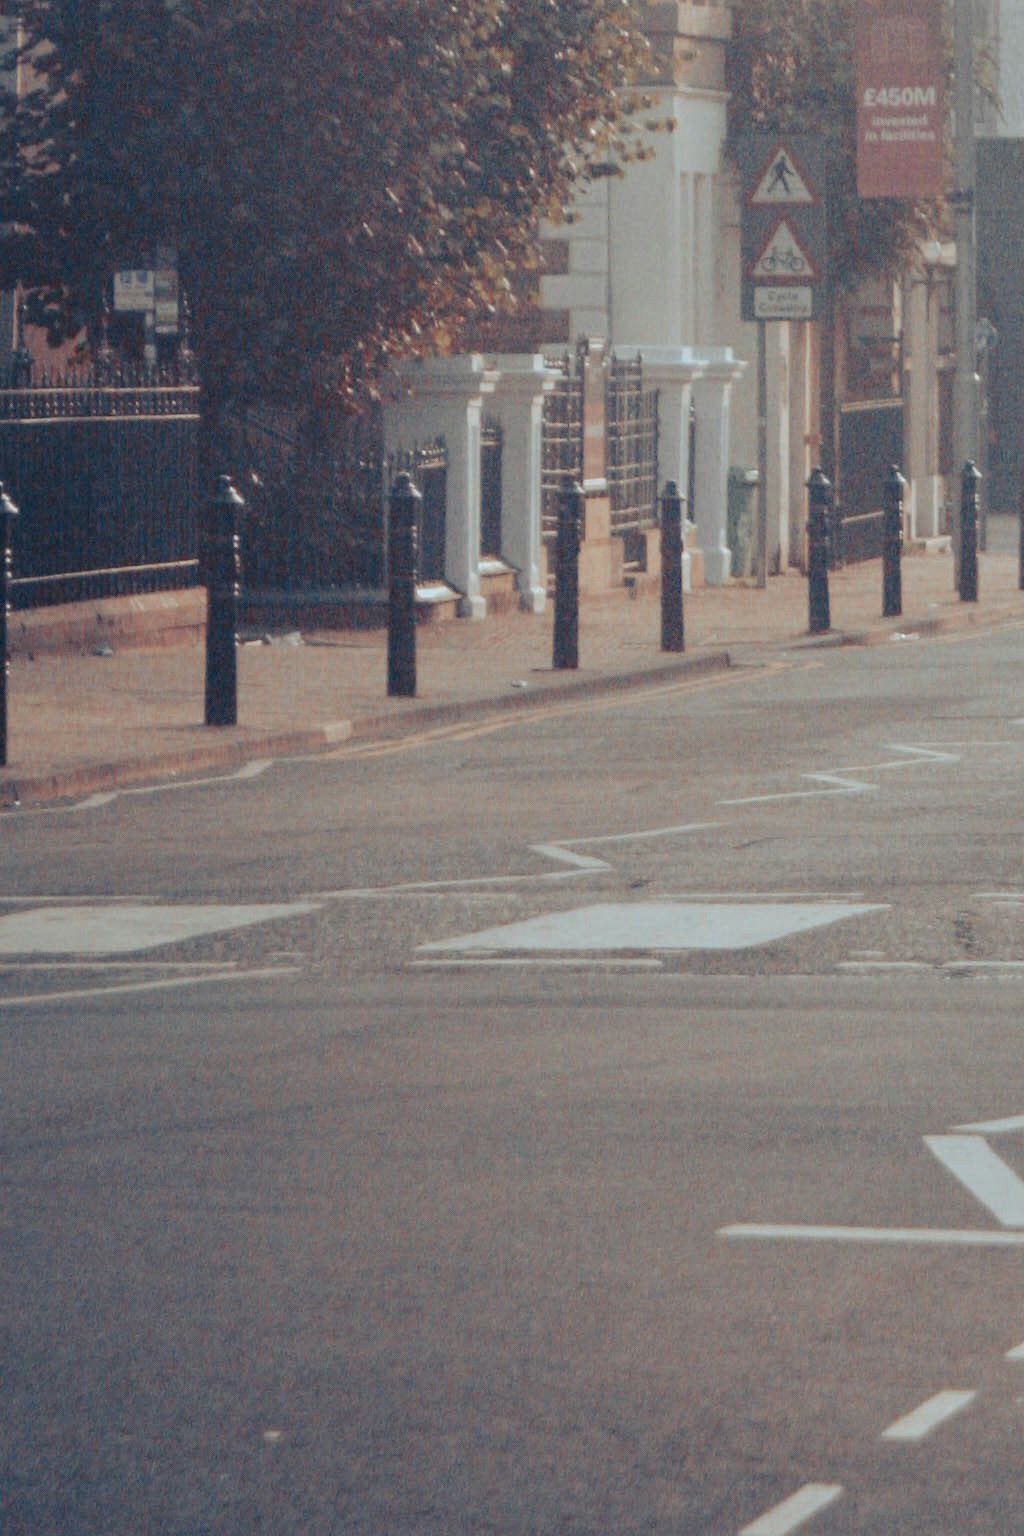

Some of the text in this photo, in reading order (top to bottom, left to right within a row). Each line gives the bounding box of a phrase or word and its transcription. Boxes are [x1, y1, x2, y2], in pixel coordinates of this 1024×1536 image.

[863, 85, 936, 107] £450M
[871, 115, 929, 127] invested
[864, 129, 936, 142] in facilities
